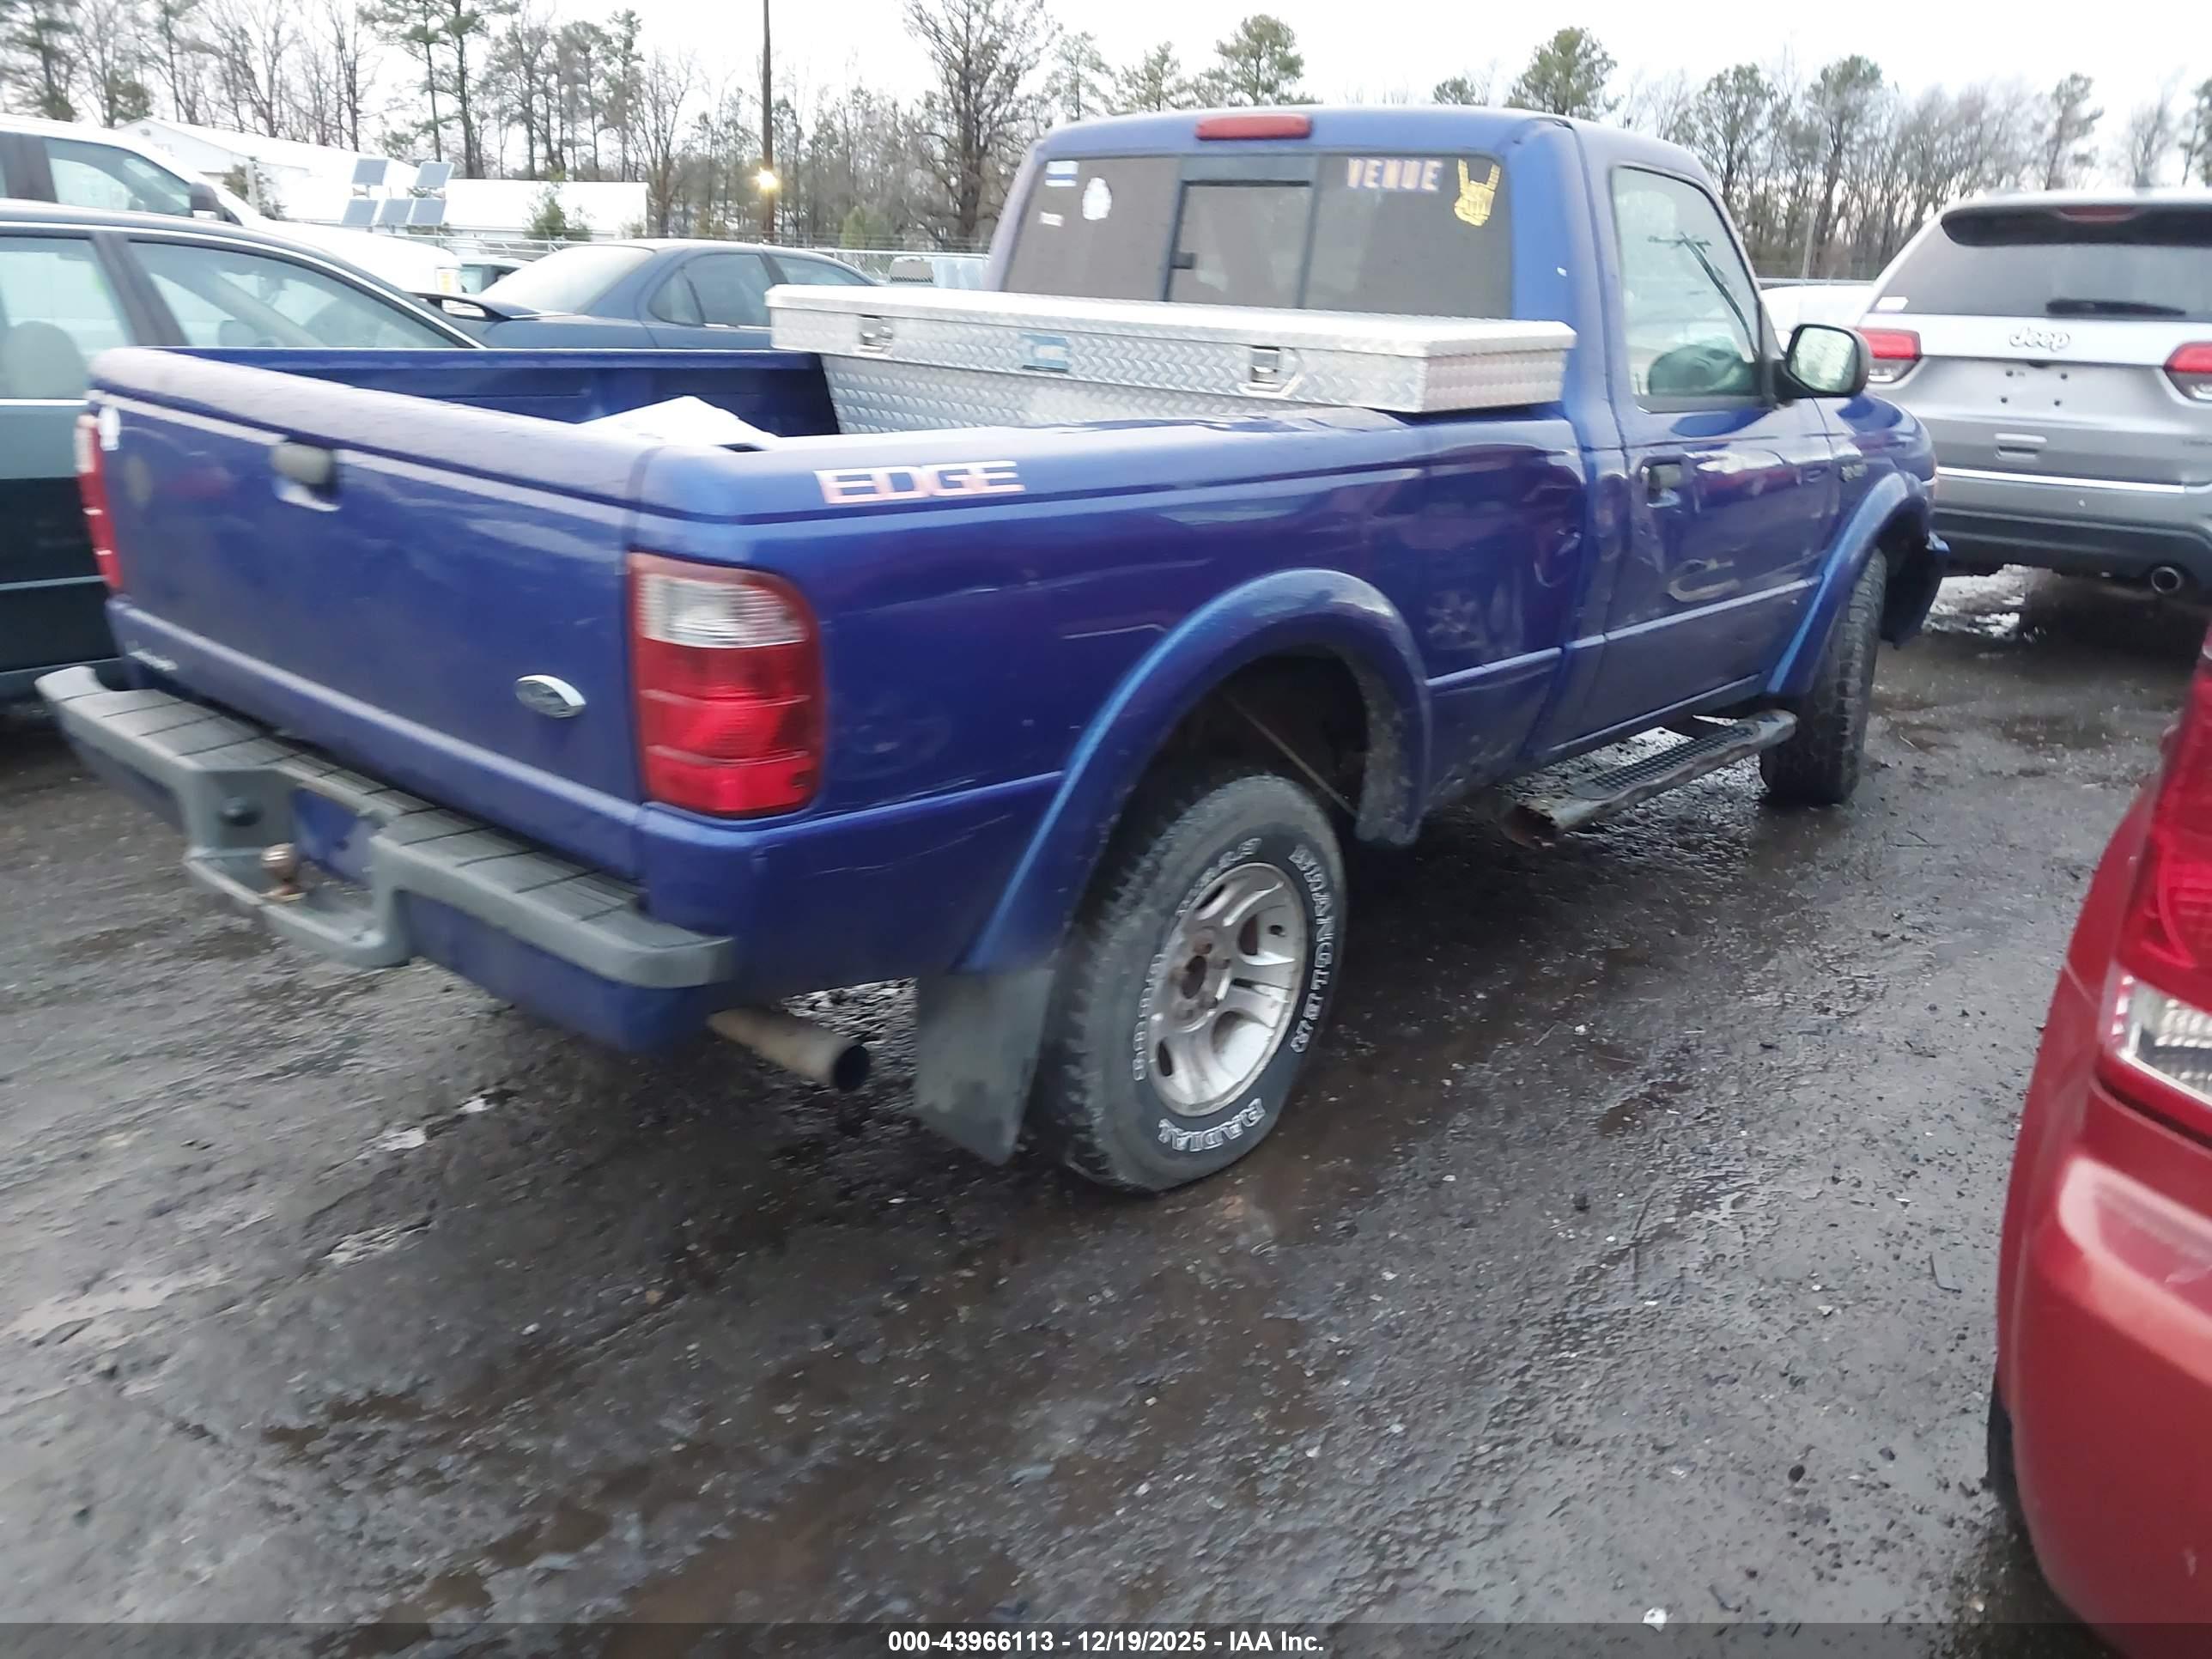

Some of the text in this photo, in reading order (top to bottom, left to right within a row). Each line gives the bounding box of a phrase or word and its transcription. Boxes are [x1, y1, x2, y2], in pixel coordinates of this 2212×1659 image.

[2008, 325, 2071, 354] Jeep
[813, 459, 1027, 505] EDGE
[1288, 843, 1334, 1054] WRANGLER
[1158, 1097, 1267, 1152] RADIAL
